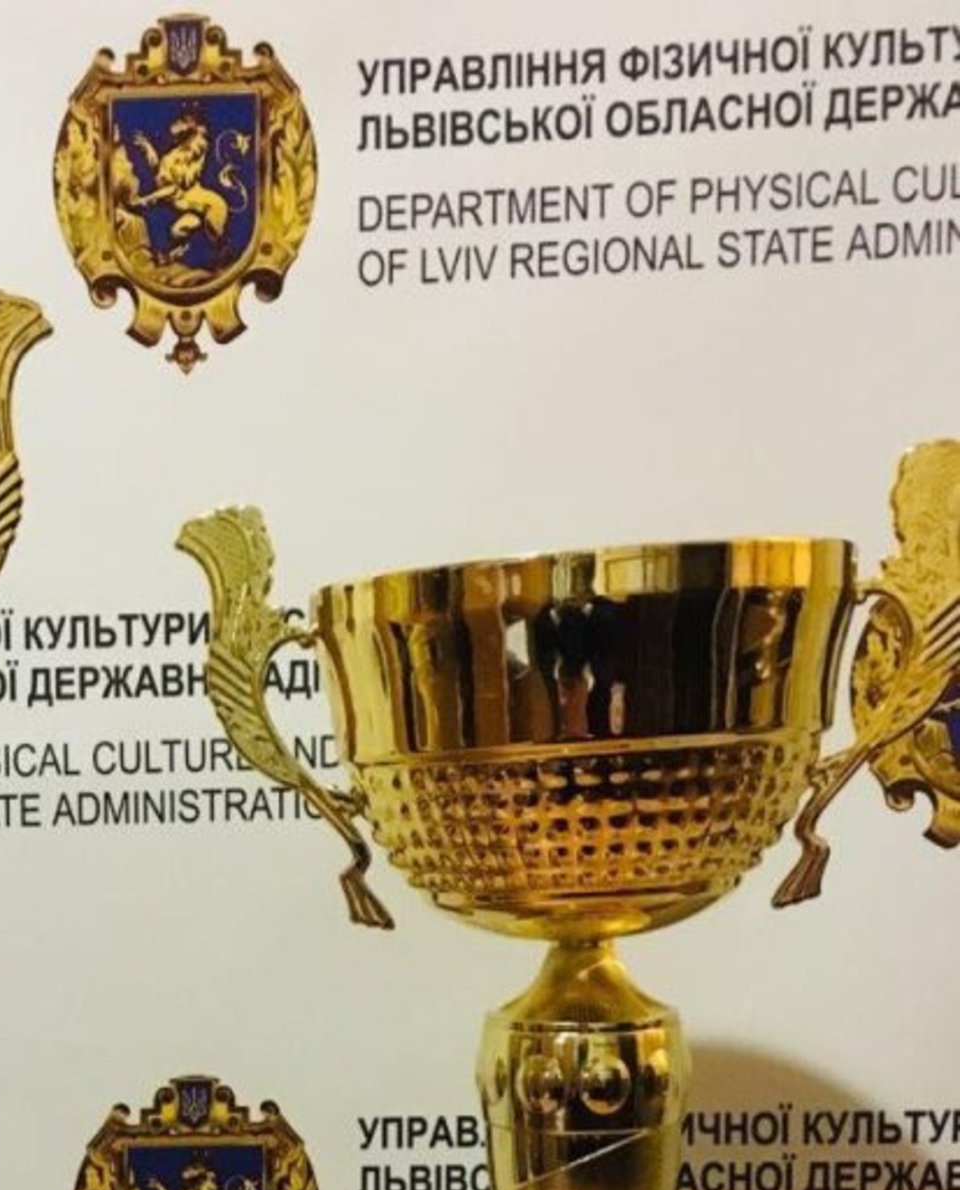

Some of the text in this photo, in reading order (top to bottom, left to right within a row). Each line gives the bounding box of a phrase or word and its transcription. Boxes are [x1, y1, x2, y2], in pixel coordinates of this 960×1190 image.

[357, 49, 606, 97] УПРАВЛІННЯ
[620, 26, 810, 82] ФІЗИЧНОЇ
[357, 95, 595, 151] ЛЬВІВСЬКОЇ
[604, 81, 815, 137] ОБЛАСНОЇ
[358, 182, 614, 233] DEPARTMENT
[625, 180, 678, 219] OF
[689, 168, 880, 214] PHYSICAL
[358, 250, 407, 288] OF
[419, 245, 499, 285] LVIV
[510, 234, 705, 280] REGIONAL
[717, 226, 835, 268] STATE
[24, 609, 210, 652] КУЛЬТУРИ
